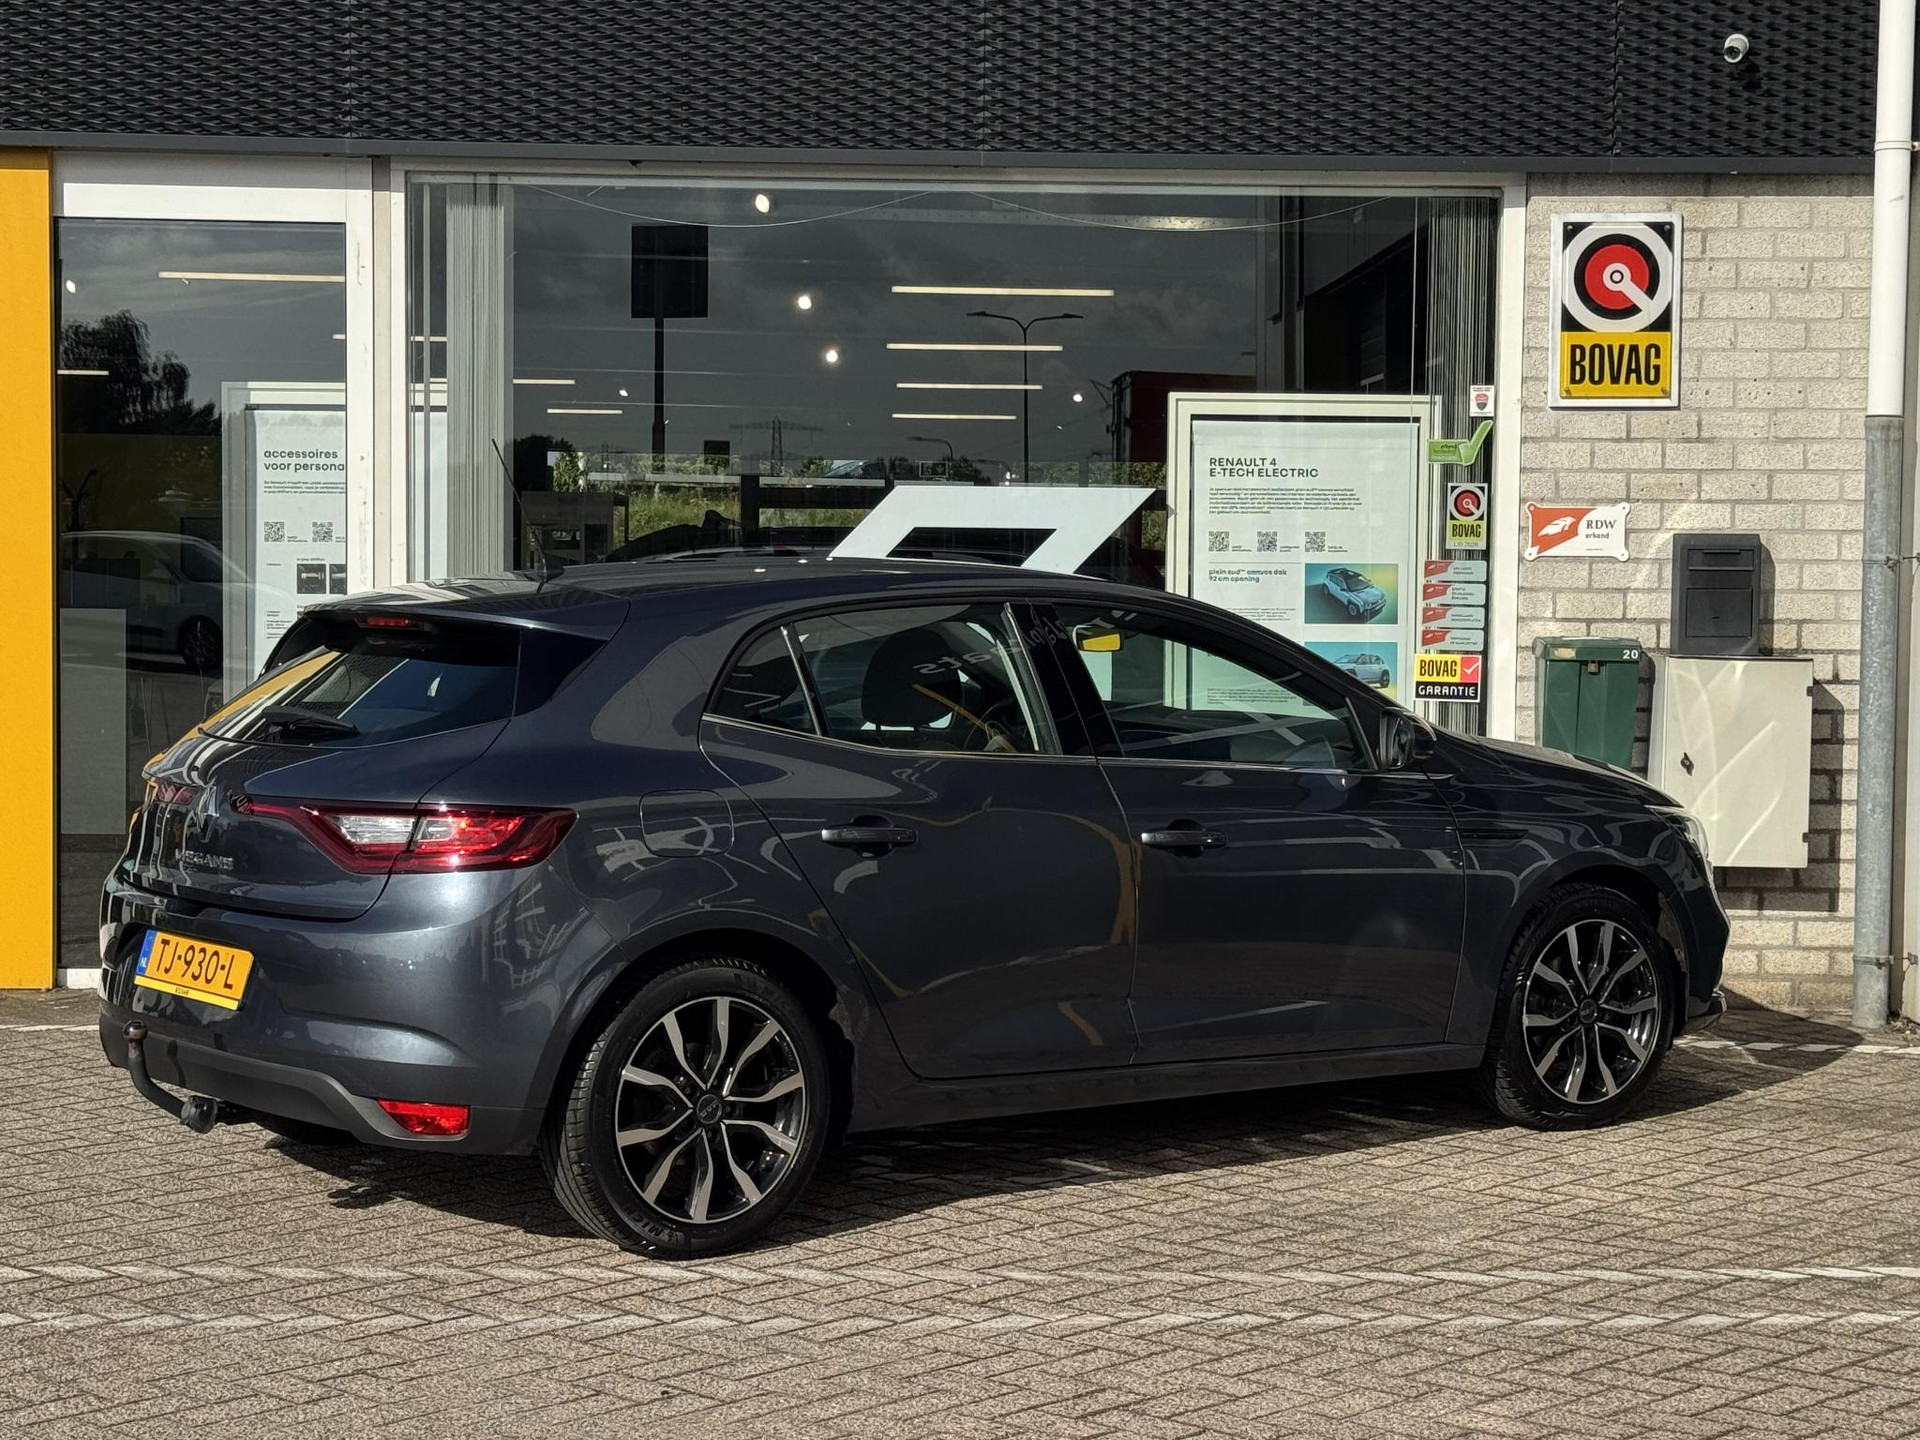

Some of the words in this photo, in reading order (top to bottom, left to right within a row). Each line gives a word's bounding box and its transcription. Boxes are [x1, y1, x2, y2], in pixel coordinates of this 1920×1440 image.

[1570, 343, 1661, 386] BOVAG
[263, 448, 338, 459] accessoires
[263, 462, 292, 471] voor
[1209, 457, 1267, 467] RENAULT
[1269, 457, 1277, 467] 4
[1209, 467, 1255, 478] E-TECH
[1257, 467, 1319, 478] ELECTRIC
[1586, 519, 1617, 529] RDW
[1452, 523, 1482, 539] BOVAG
[1273, 568, 1287, 576] dak
[1230, 575, 1260, 584] opening
[1622, 649, 1639, 660] 20
[1419, 659, 1457, 678] BOVAG
[1418, 685, 1476, 697] GARANTIE
[156, 938, 235, 990] TJ-930-L
